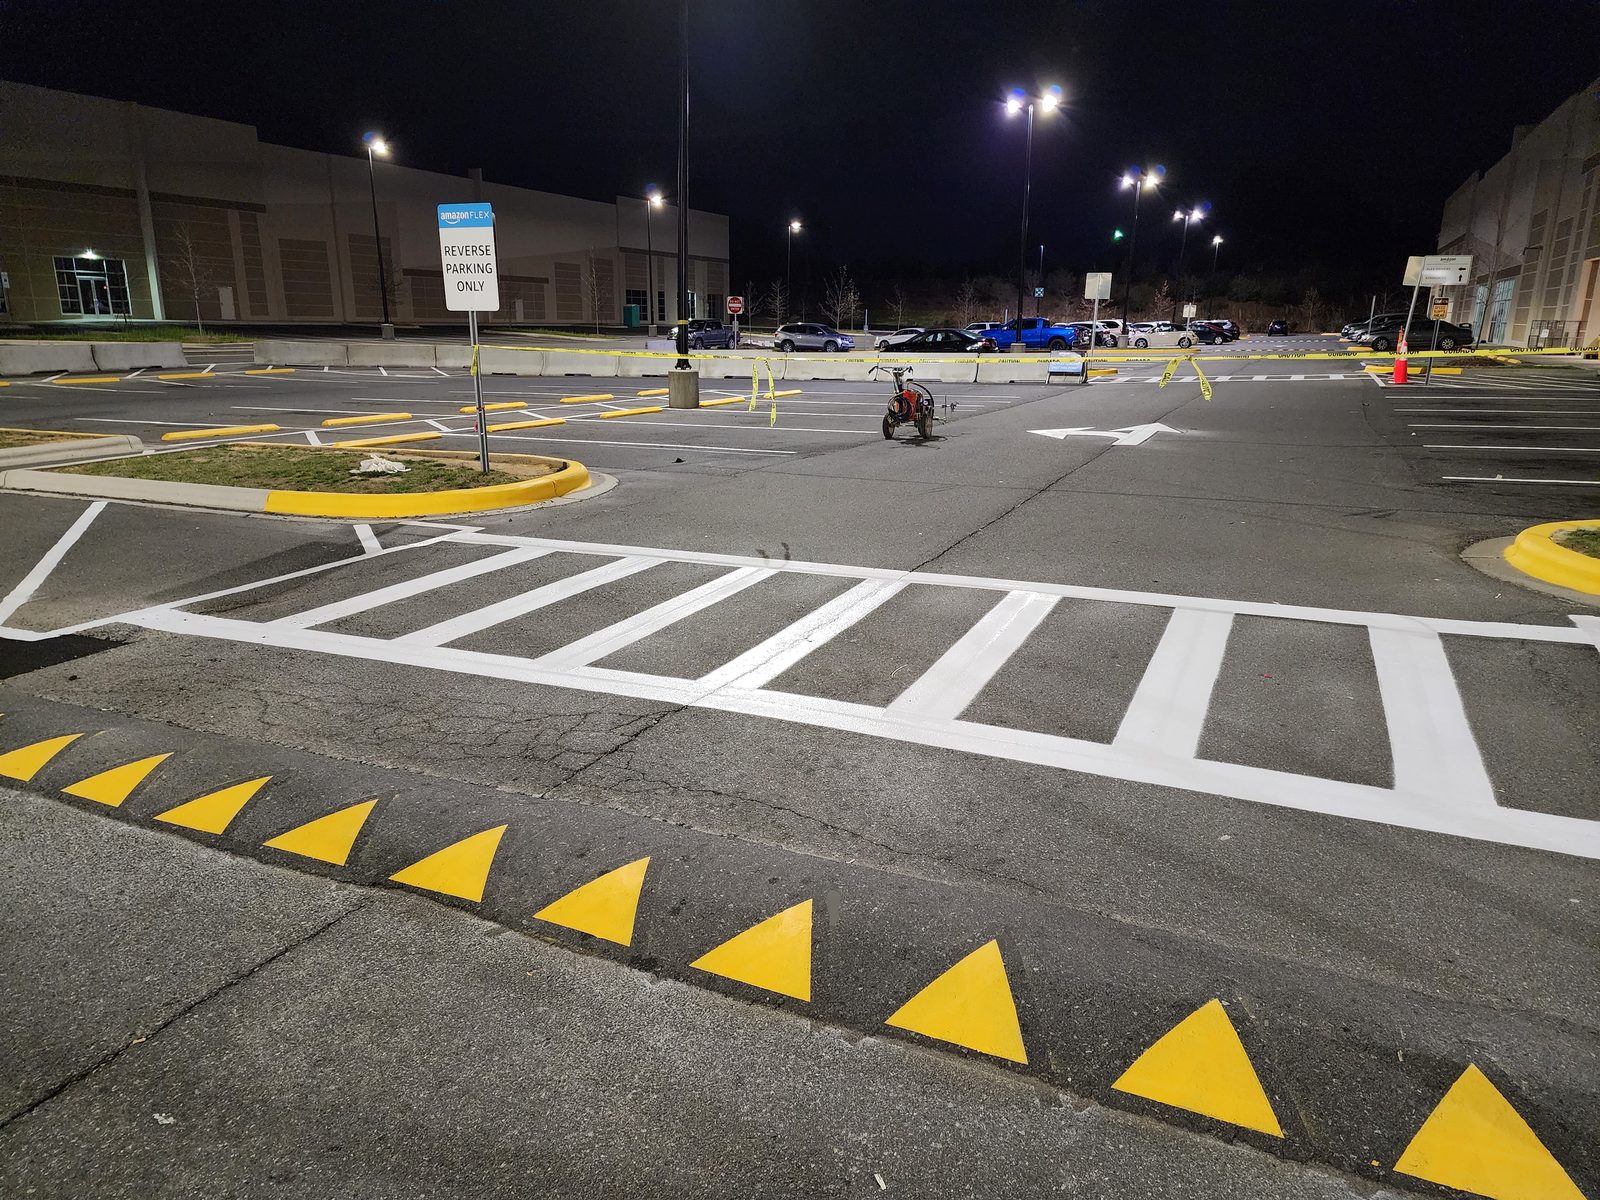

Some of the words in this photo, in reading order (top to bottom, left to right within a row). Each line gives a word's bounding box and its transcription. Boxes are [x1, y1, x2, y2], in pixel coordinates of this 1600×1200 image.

[444, 244, 491, 257] REVERSE
[446, 262, 493, 275] PARKING
[456, 280, 485, 292] ONLY
